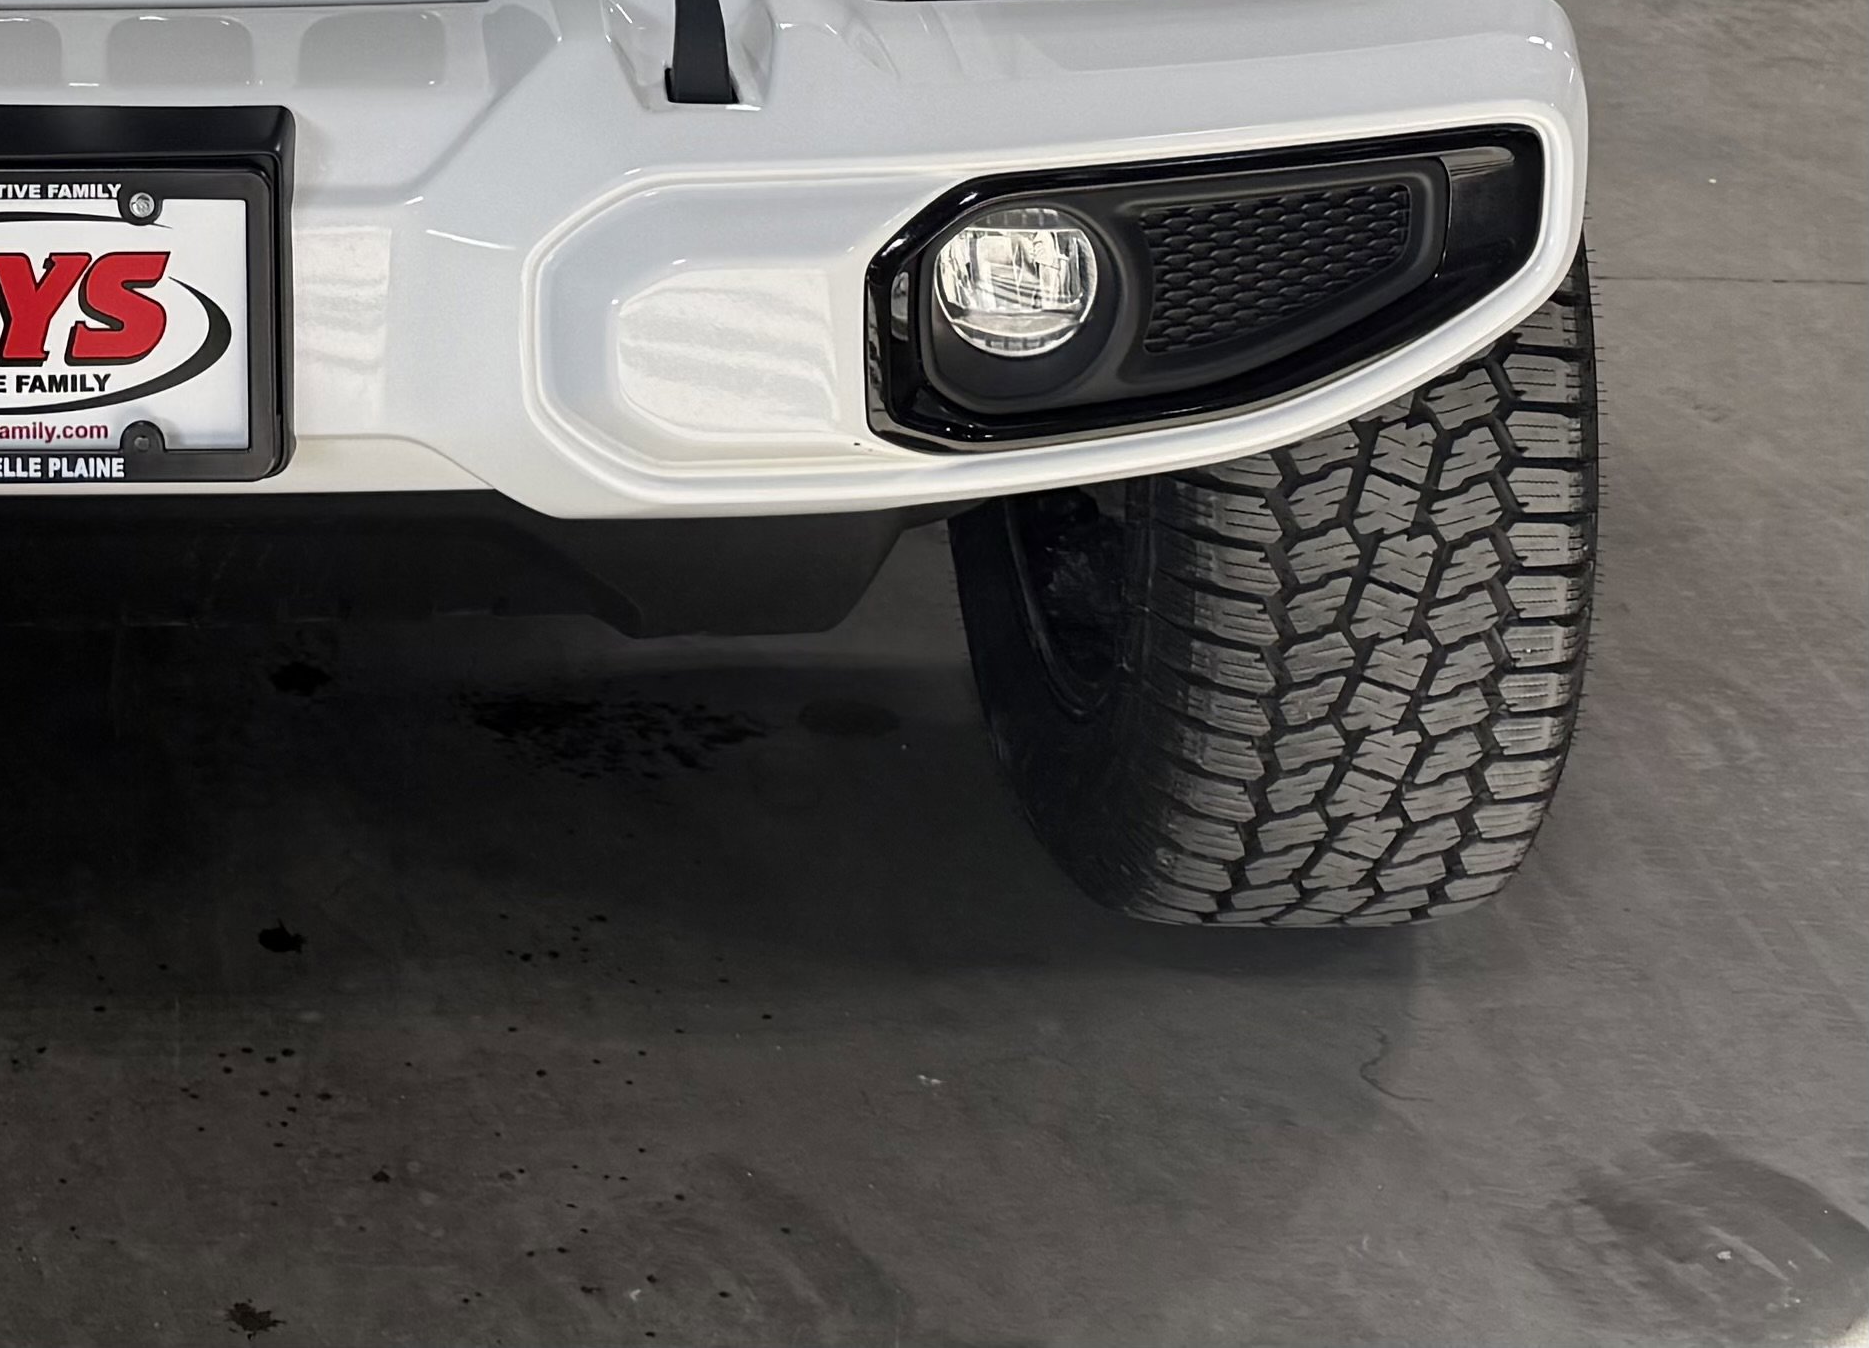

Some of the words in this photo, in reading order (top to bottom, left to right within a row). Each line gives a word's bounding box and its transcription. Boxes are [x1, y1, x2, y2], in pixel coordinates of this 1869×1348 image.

[45, 182, 122, 199] FAMILY
[15, 372, 112, 393] FAMILY
[48, 455, 125, 478] PLAINE
